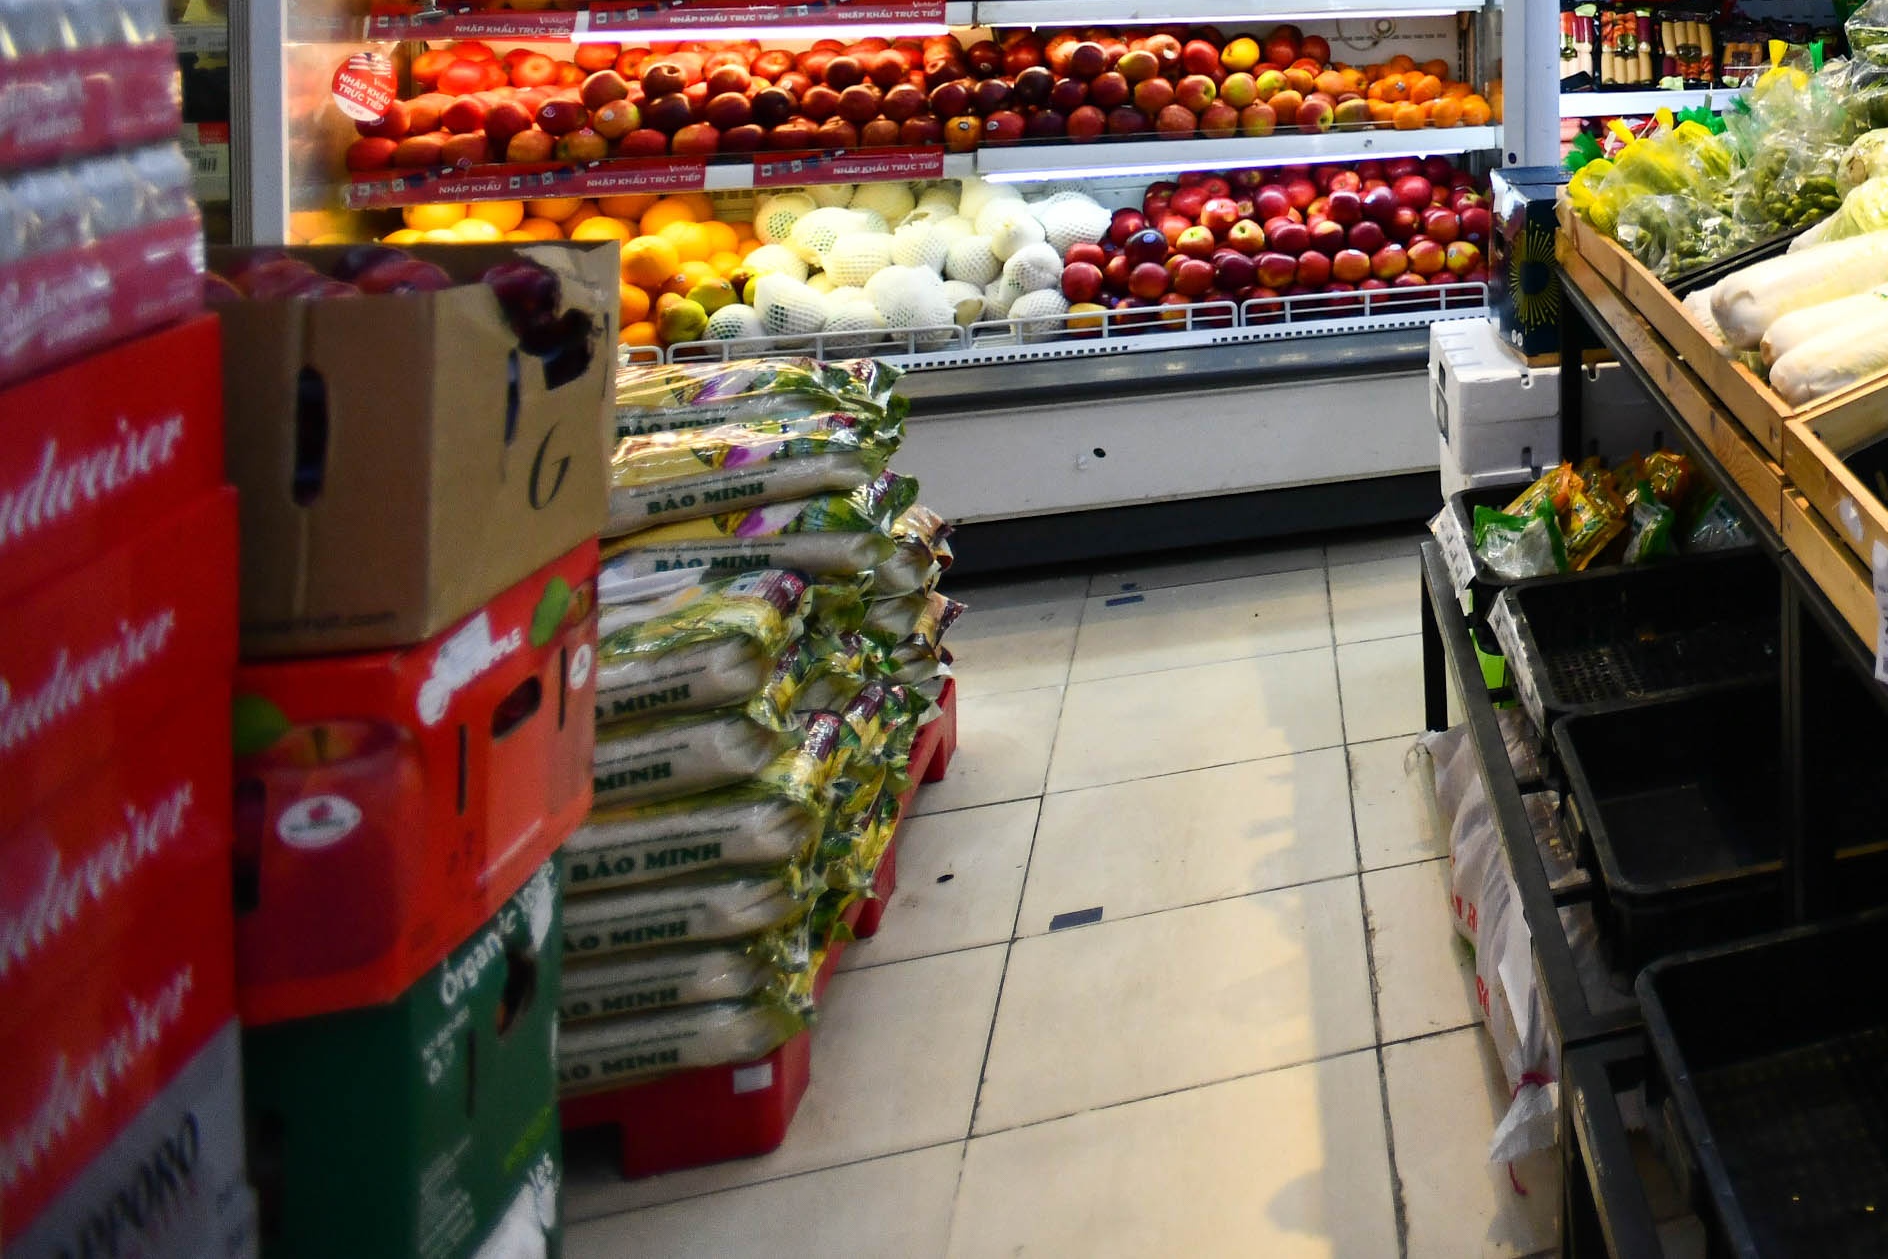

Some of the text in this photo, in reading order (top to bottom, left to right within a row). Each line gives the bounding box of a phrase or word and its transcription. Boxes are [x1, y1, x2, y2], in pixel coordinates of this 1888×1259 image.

[647, 490, 696, 516] BẢO
[702, 480, 765, 505] MINH
[711, 552, 770, 570] MINH
[612, 683, 692, 718] MINH
[594, 762, 672, 793] MINH
[571, 842, 721, 883] BẢO MINH
[611, 920, 688, 949] MINH
[602, 987, 679, 1015] MINH
[602, 1047, 679, 1076] MINH
